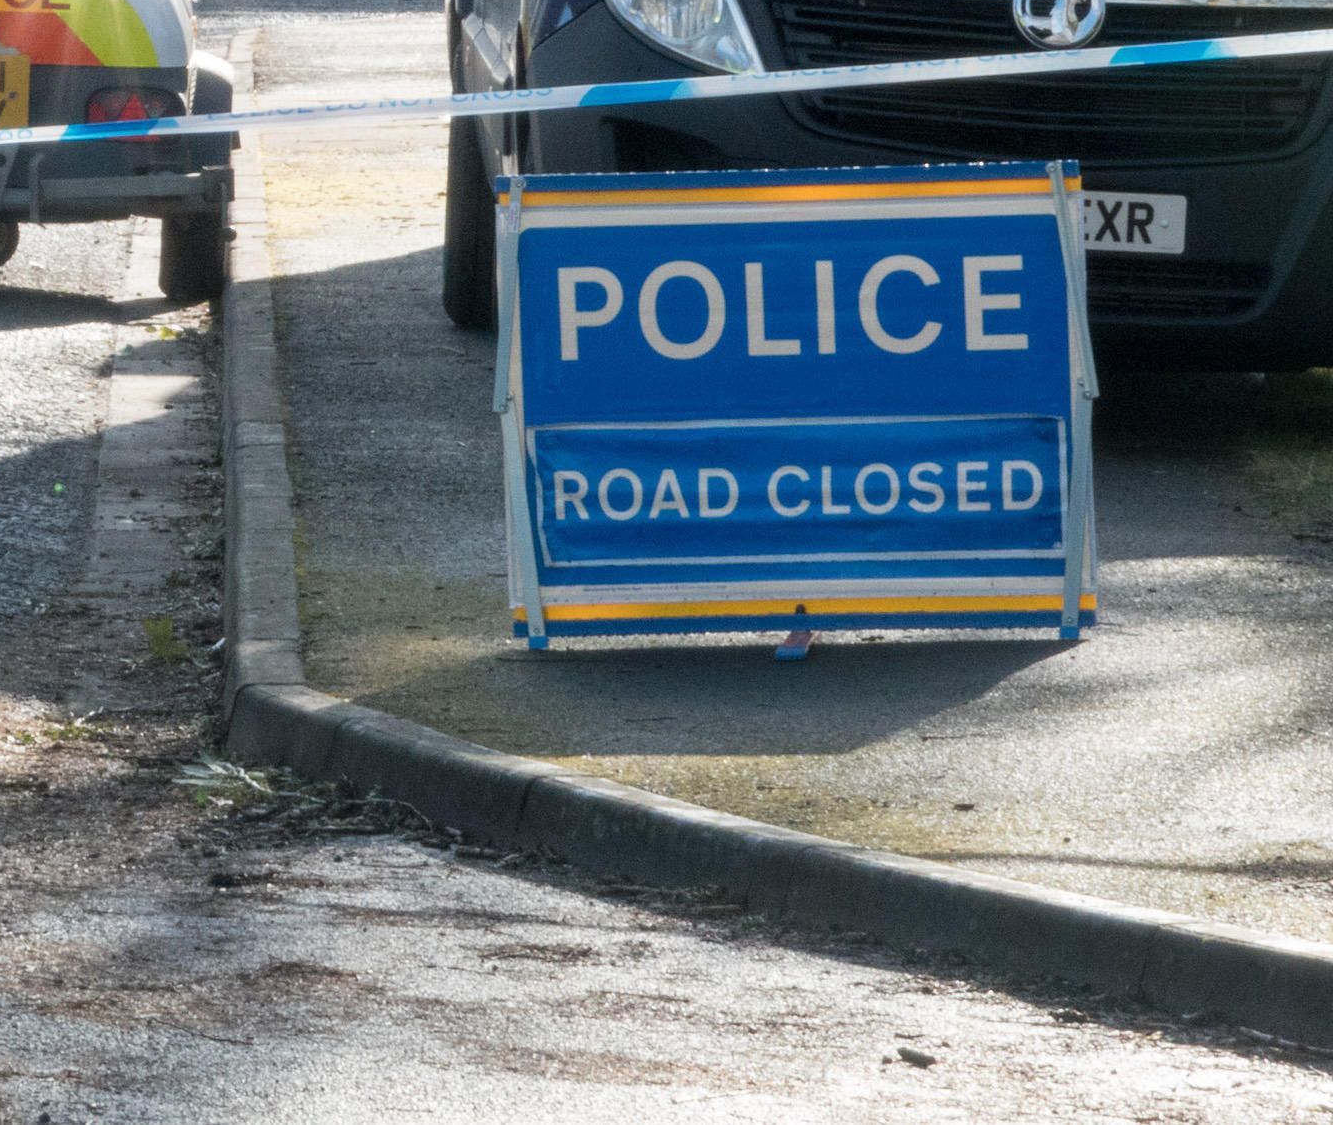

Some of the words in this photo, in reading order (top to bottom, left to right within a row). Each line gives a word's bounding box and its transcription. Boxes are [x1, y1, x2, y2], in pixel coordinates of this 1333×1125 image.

[556, 255, 1030, 361] POLICE
[552, 466, 740, 521] ROAD
[766, 459, 1045, 518] CLOSED
